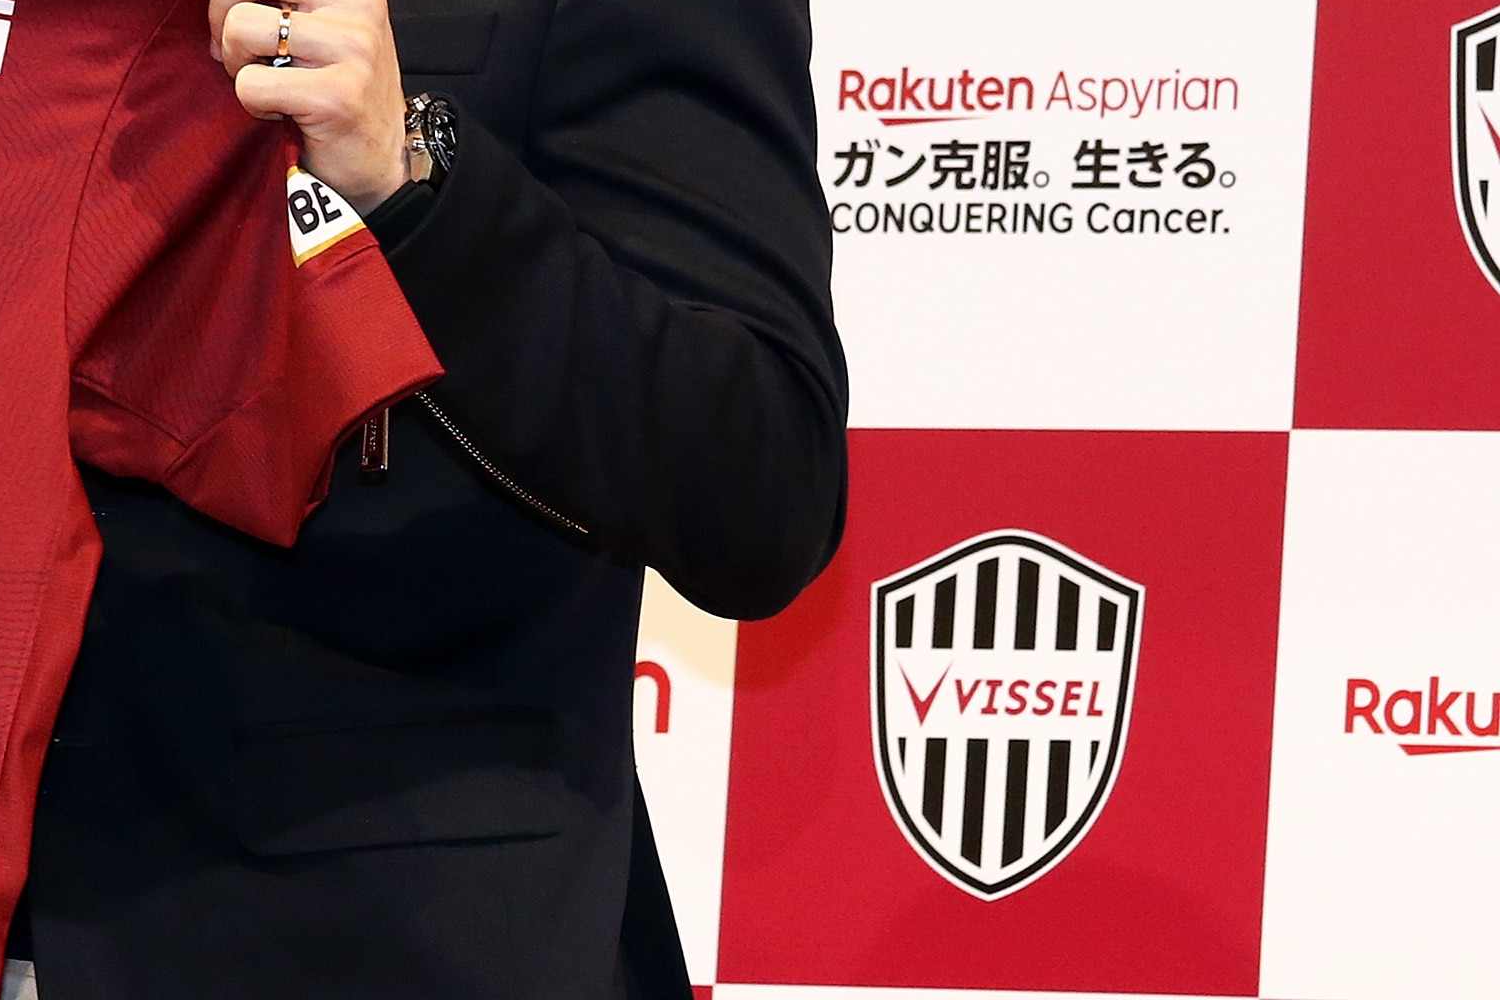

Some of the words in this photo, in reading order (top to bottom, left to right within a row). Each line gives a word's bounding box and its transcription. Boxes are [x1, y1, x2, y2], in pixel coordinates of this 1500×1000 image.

[838, 66, 1034, 112] Rakuten
[1045, 69, 1239, 119] Aspyrian
[831, 202, 1074, 234] CONQUERING
[1086, 202, 1230, 234] Cancer.
[954, 679, 1105, 717] VISSEL
[1344, 676, 1500, 738] Raku
